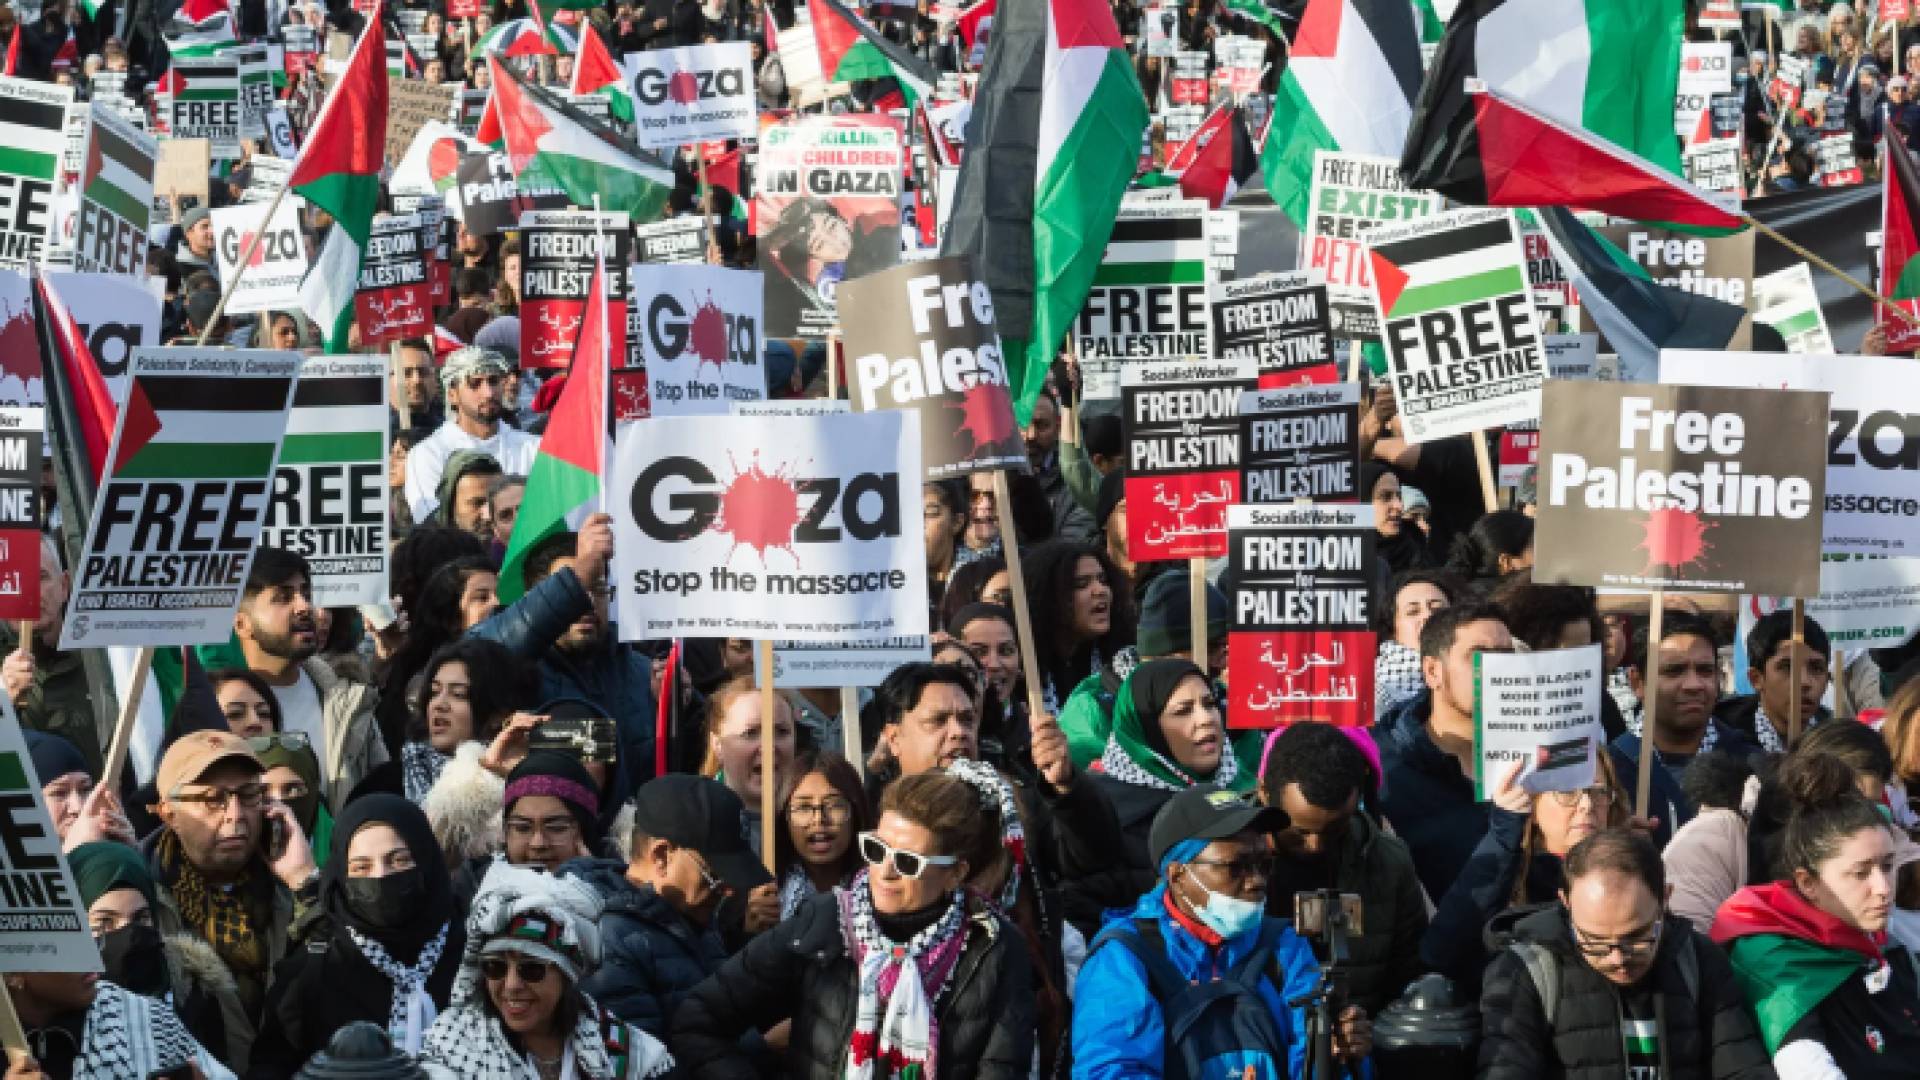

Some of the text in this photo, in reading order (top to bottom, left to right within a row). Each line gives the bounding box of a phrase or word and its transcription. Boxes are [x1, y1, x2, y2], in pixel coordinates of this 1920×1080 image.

[635, 67, 743, 105] Gza
[175, 102, 238, 125] FREE
[803, 150, 897, 165] CHILDREN
[1322, 158, 1355, 188] FREE
[766, 168, 894, 194] IN GAZA
[80, 200, 147, 281] FREE
[221, 226, 298, 266] Gza
[1628, 232, 1707, 265] Free
[524, 270, 622, 296] PALESTE
[907, 274, 994, 334] Fre
[1080, 285, 1206, 334] FREE
[1222, 290, 1319, 332] FREEDOM
[648, 293, 757, 366] Gza
[1080, 334, 1208, 360] PALESTINE
[1386, 294, 1537, 373] FREE
[137, 356, 186, 371] Palestine
[189, 356, 242, 373] Solidarity
[1223, 333, 1329, 369] PALESTINE
[688, 379, 719, 398] the
[1398, 346, 1542, 397] PALESTINE
[1135, 386, 1243, 423] FREEDOM
[1252, 412, 1348, 452] FREEDOM
[1619, 396, 1745, 455] Free
[1131, 434, 1240, 471] PALESTIN
[264, 464, 384, 527] REE
[630, 456, 902, 543] Gza
[1153, 479, 1233, 511] الحرية
[1247, 461, 1353, 503] PALESTINE
[1549, 453, 1813, 520] Palestine
[92, 481, 266, 552] FREE
[1824, 494, 1919, 518] ssacre
[260, 527, 384, 557] LESTINE
[1244, 536, 1362, 571] FREEDOM
[80, 553, 248, 589] PALESTINE
[634, 566, 906, 597] Stop the massacre
[1236, 590, 1369, 625] PALESTINE
[1259, 640, 1345, 676] الحرية
[1247, 676, 1358, 710] لفلسطين
